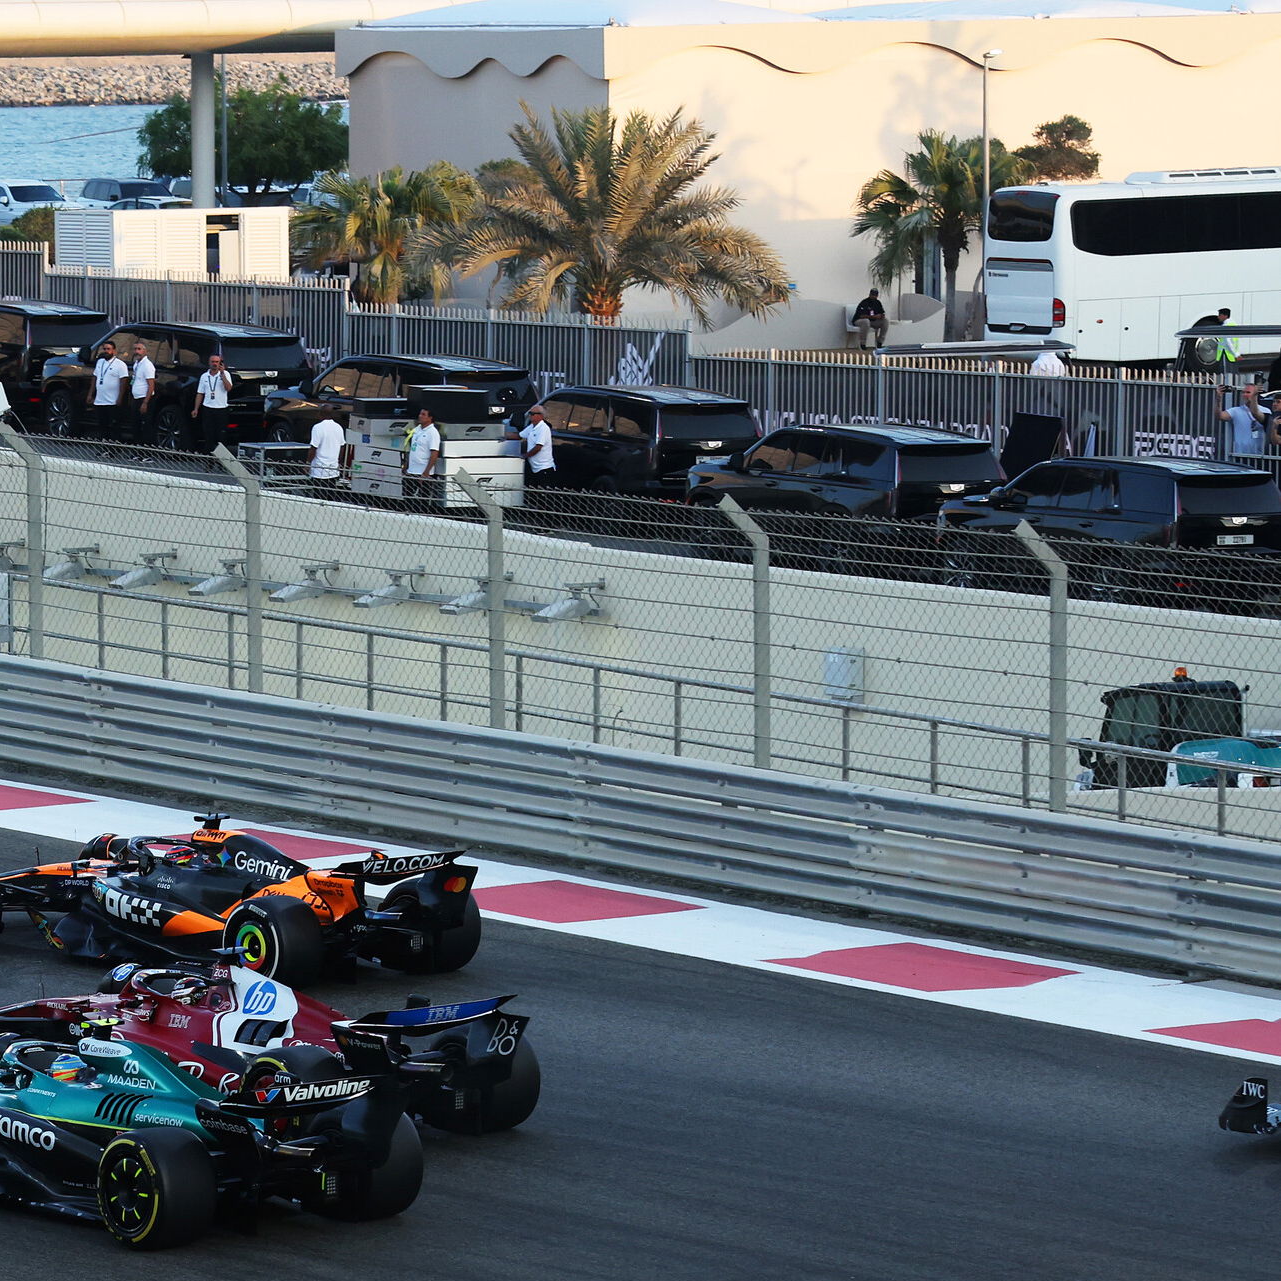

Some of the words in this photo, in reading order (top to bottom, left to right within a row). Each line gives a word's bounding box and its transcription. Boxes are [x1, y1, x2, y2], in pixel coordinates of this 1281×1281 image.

[234, 850, 294, 883] Gemini
[361, 853, 446, 875] VELO.COM
[213, 968, 228, 978] ZCG
[243, 980, 278, 1015] hp
[168, 1013, 192, 1029] IBM
[425, 1004, 461, 1023] IBM
[107, 1073, 157, 1090] MAADEN
[274, 1073, 291, 1085] arm
[283, 1080, 371, 1102] Valvoline
[1242, 1081, 1266, 1099] IWC
[134, 1112, 184, 1128] servicenow
[199, 1117, 249, 1135] coinbase
